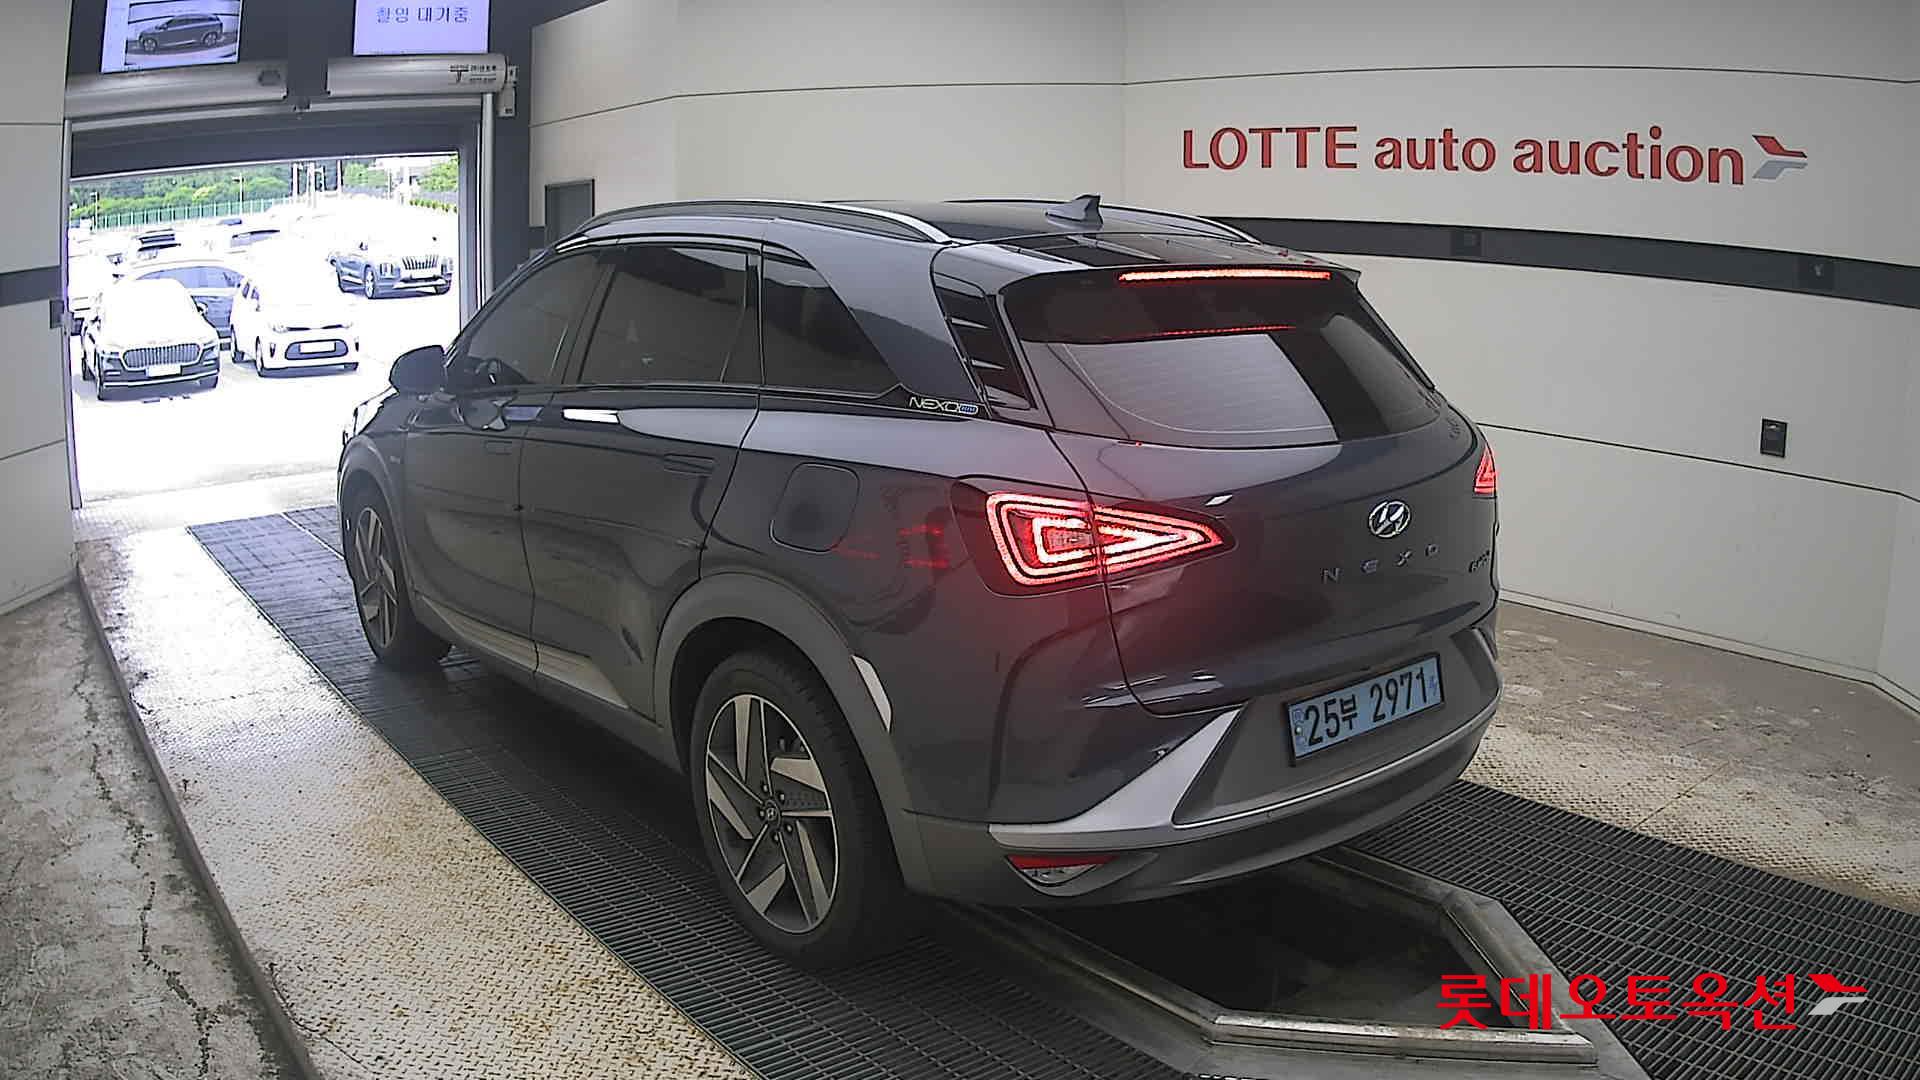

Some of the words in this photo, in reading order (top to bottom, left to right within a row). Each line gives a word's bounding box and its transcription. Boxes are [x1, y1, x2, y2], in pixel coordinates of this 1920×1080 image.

[418, 7, 468, 23] 대기중
[1183, 126, 1358, 169] LOTTE
[1374, 128, 1496, 171] auto
[1512, 125, 1744, 185] auction
[909, 396, 959, 412] NEXO
[1305, 694, 1358, 746] 25부
[1370, 667, 1427, 722] 2971
